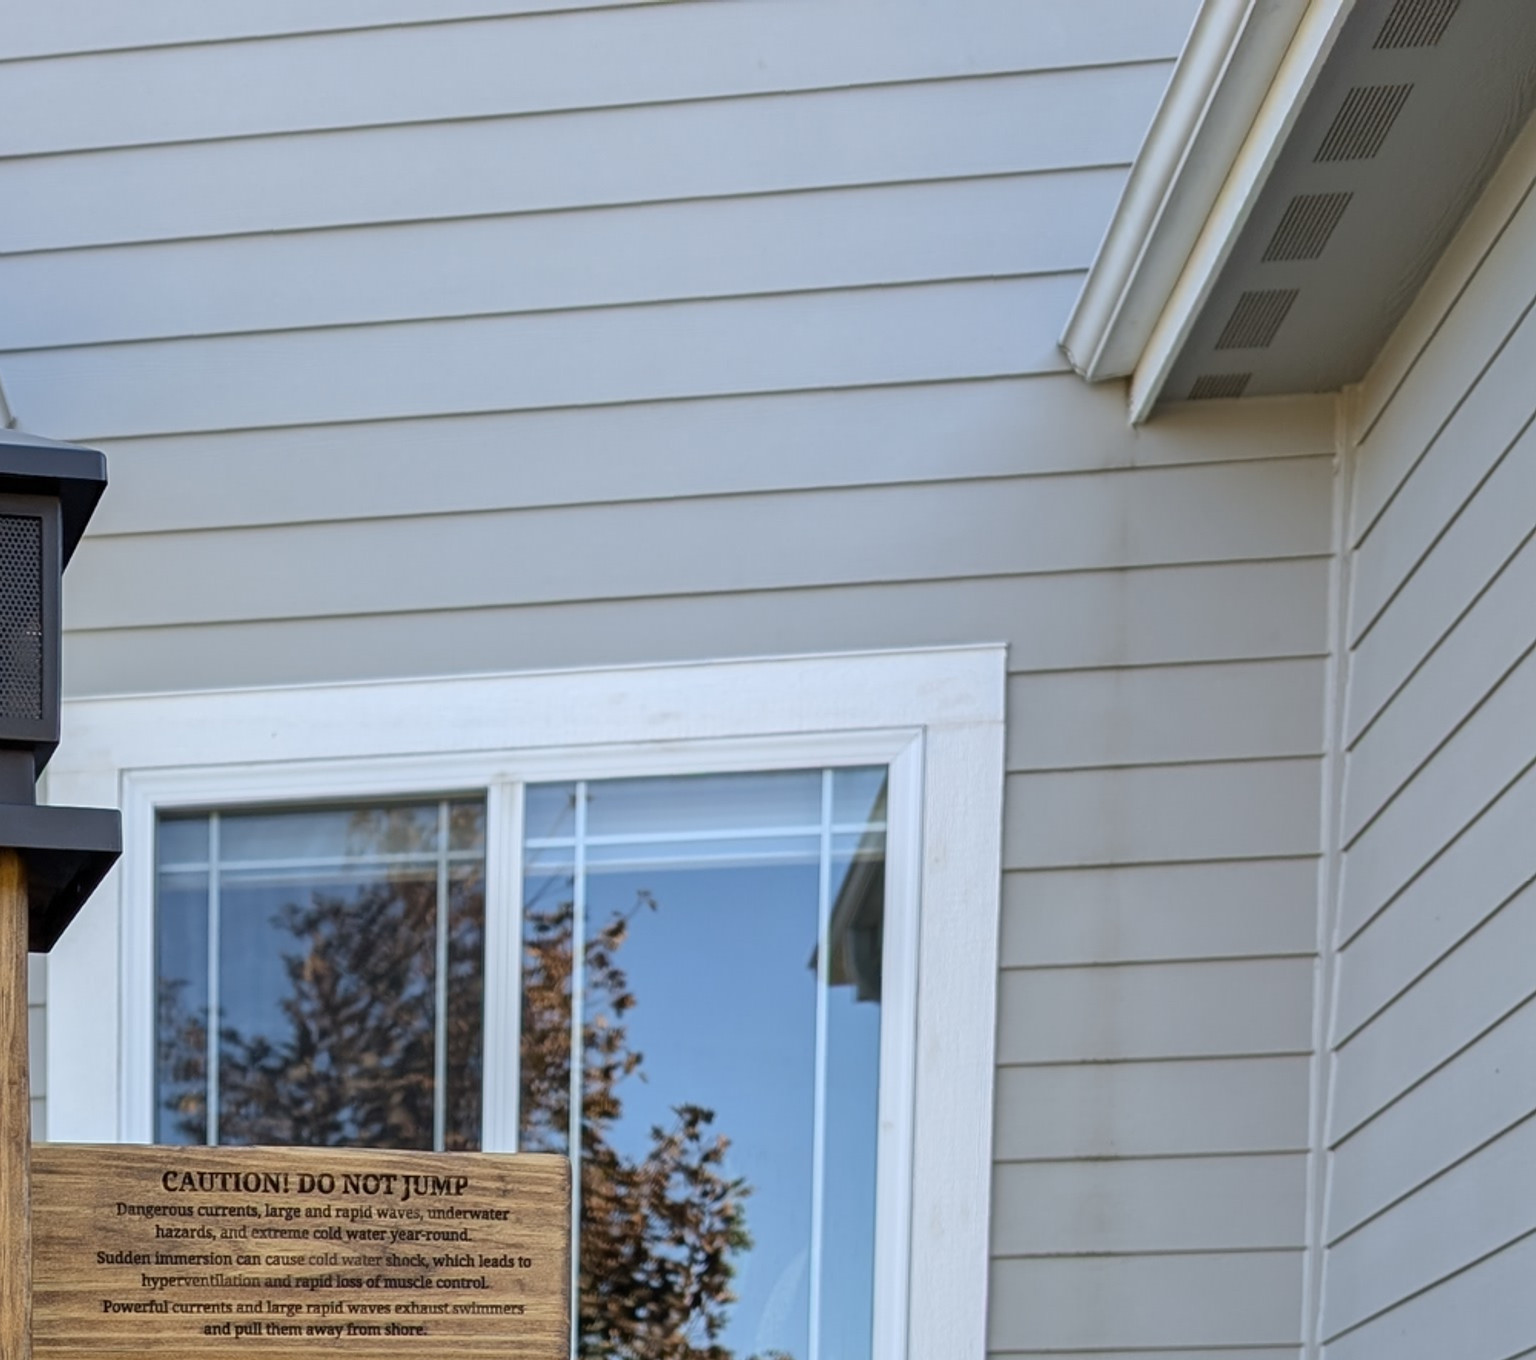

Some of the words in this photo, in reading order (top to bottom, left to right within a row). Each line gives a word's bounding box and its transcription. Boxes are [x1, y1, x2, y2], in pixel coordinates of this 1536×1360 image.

[162, 1170, 289, 1192] CAUTION!
[297, 1173, 336, 1193] DO
[342, 1174, 396, 1195] NOT
[398, 1175, 469, 1201] JUMP
[116, 1202, 194, 1219] Dangerous
[197, 1204, 261, 1219] currents,
[265, 1203, 301, 1221] large
[305, 1206, 331, 1218] and
[335, 1207, 372, 1222] rapid
[376, 1210, 424, 1221] waves,
[427, 1207, 510, 1221] underwater
[155, 1224, 216, 1241] hazards,
[220, 1225, 246, 1239] and
[251, 1228, 309, 1239] extreme
[313, 1227, 341, 1240] cold
[346, 1230, 387, 1241] water
[390, 1229, 472, 1244] year-round.
[97, 1251, 151, 1264] Sudden
[155, 1252, 233, 1265] immersion
[236, 1254, 261, 1266] can
[265, 1254, 305, 1266] cause
[309, 1253, 338, 1266] cold
[342, 1255, 382, 1267] water
[386, 1254, 429, 1269] shock,
[432, 1254, 475, 1267] which
[479, 1255, 514, 1268] leads
[518, 1257, 532, 1268] to
[141, 1273, 260, 1291] hyperventilation
[264, 1275, 292, 1288] and
[295, 1275, 332, 1291] rapid
[336, 1276, 362, 1288] loss
[366, 1276, 382, 1288] of
[384, 1276, 432, 1289] muscle
[436, 1277, 490, 1289] control.
[103, 1300, 168, 1313] Powerful
[172, 1302, 233, 1314] currents
[236, 1302, 263, 1314] and
[267, 1301, 302, 1317] large
[306, 1302, 343, 1317] rapid
[347, 1305, 391, 1314] waves
[395, 1302, 450, 1314] exhaust
[453, 1302, 525, 1315] swimmers
[204, 1323, 230, 1335] and
[234, 1323, 262, 1339] pull
[266, 1323, 302, 1336] them
[306, 1325, 343, 1339] away
[347, 1323, 381, 1336] from
[384, 1323, 427, 1336] shore.
